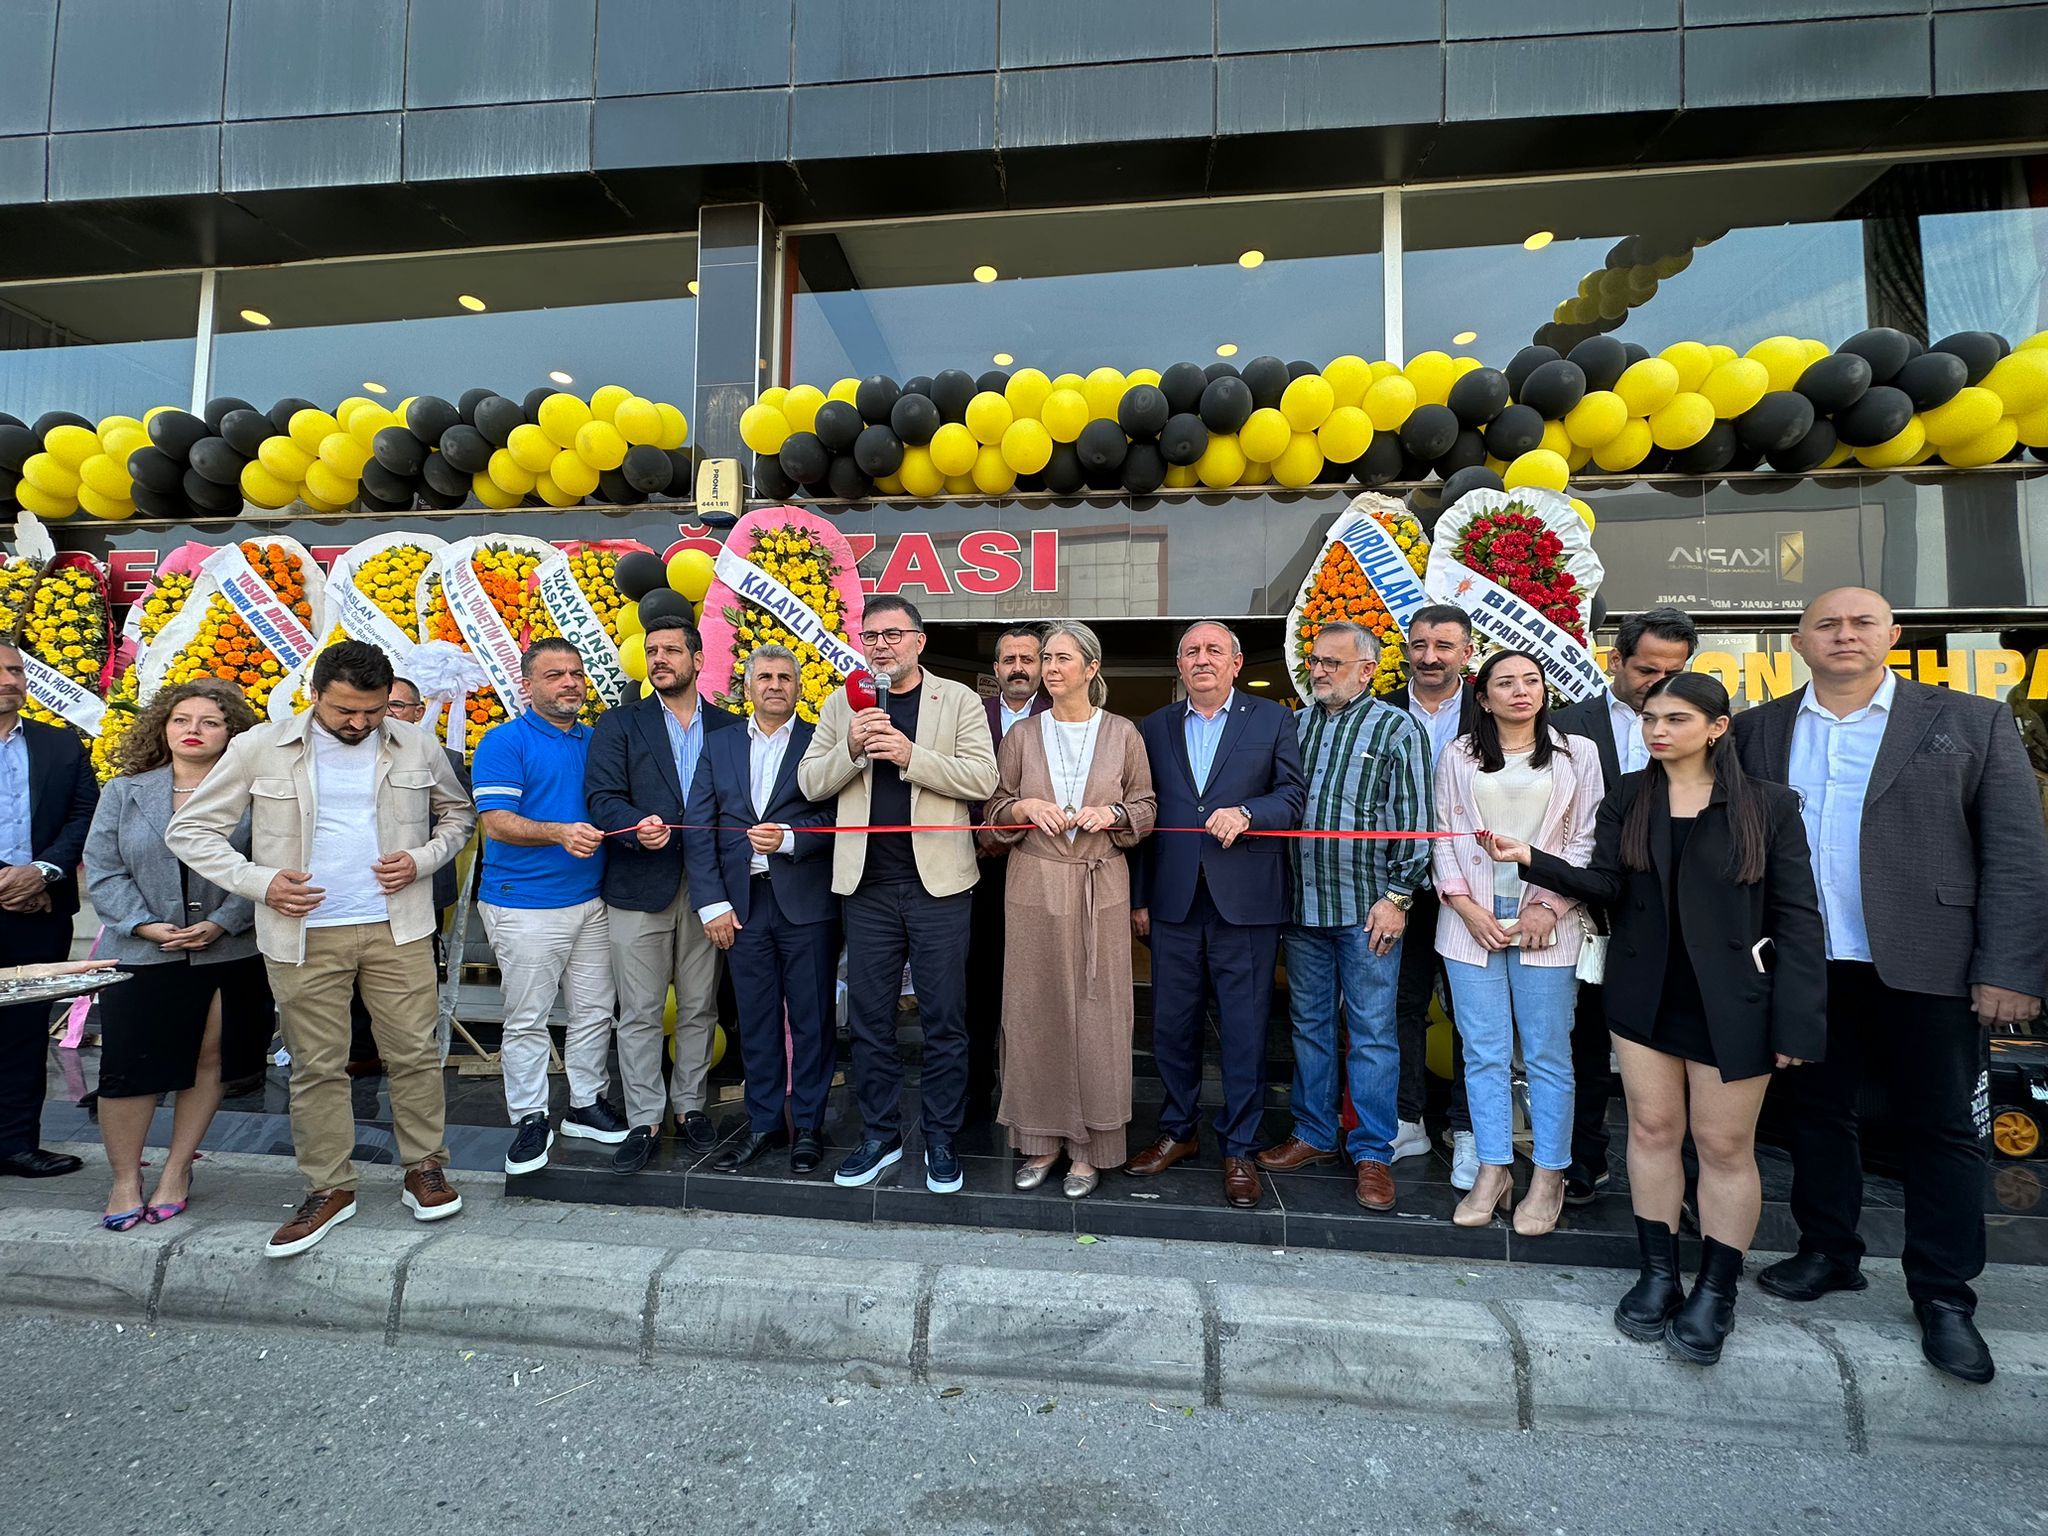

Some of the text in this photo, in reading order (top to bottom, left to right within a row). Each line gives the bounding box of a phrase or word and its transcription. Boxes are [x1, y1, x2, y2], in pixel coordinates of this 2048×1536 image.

[711, 468, 720, 499] PRONET
[235, 571, 272, 606] YUSUF
[445, 568, 467, 616] ELİF
[552, 567, 588, 628] ÖZKAYA
[246, 609, 286, 649] BELEDİYE
[363, 621, 391, 650] Güvenlik
[467, 595, 502, 641] YÖNETİM
[738, 571, 872, 673] KALAYLI TEKS
[1482, 589, 1558, 648] BİLAL
[541, 577, 620, 708] HASAN ÖZKAYA
[1469, 607, 1492, 627] AK
[1568, 676, 1585, 698] İL
[24, 659, 84, 703] METAL PROFİL
[26, 679, 69, 712] RAMAN
